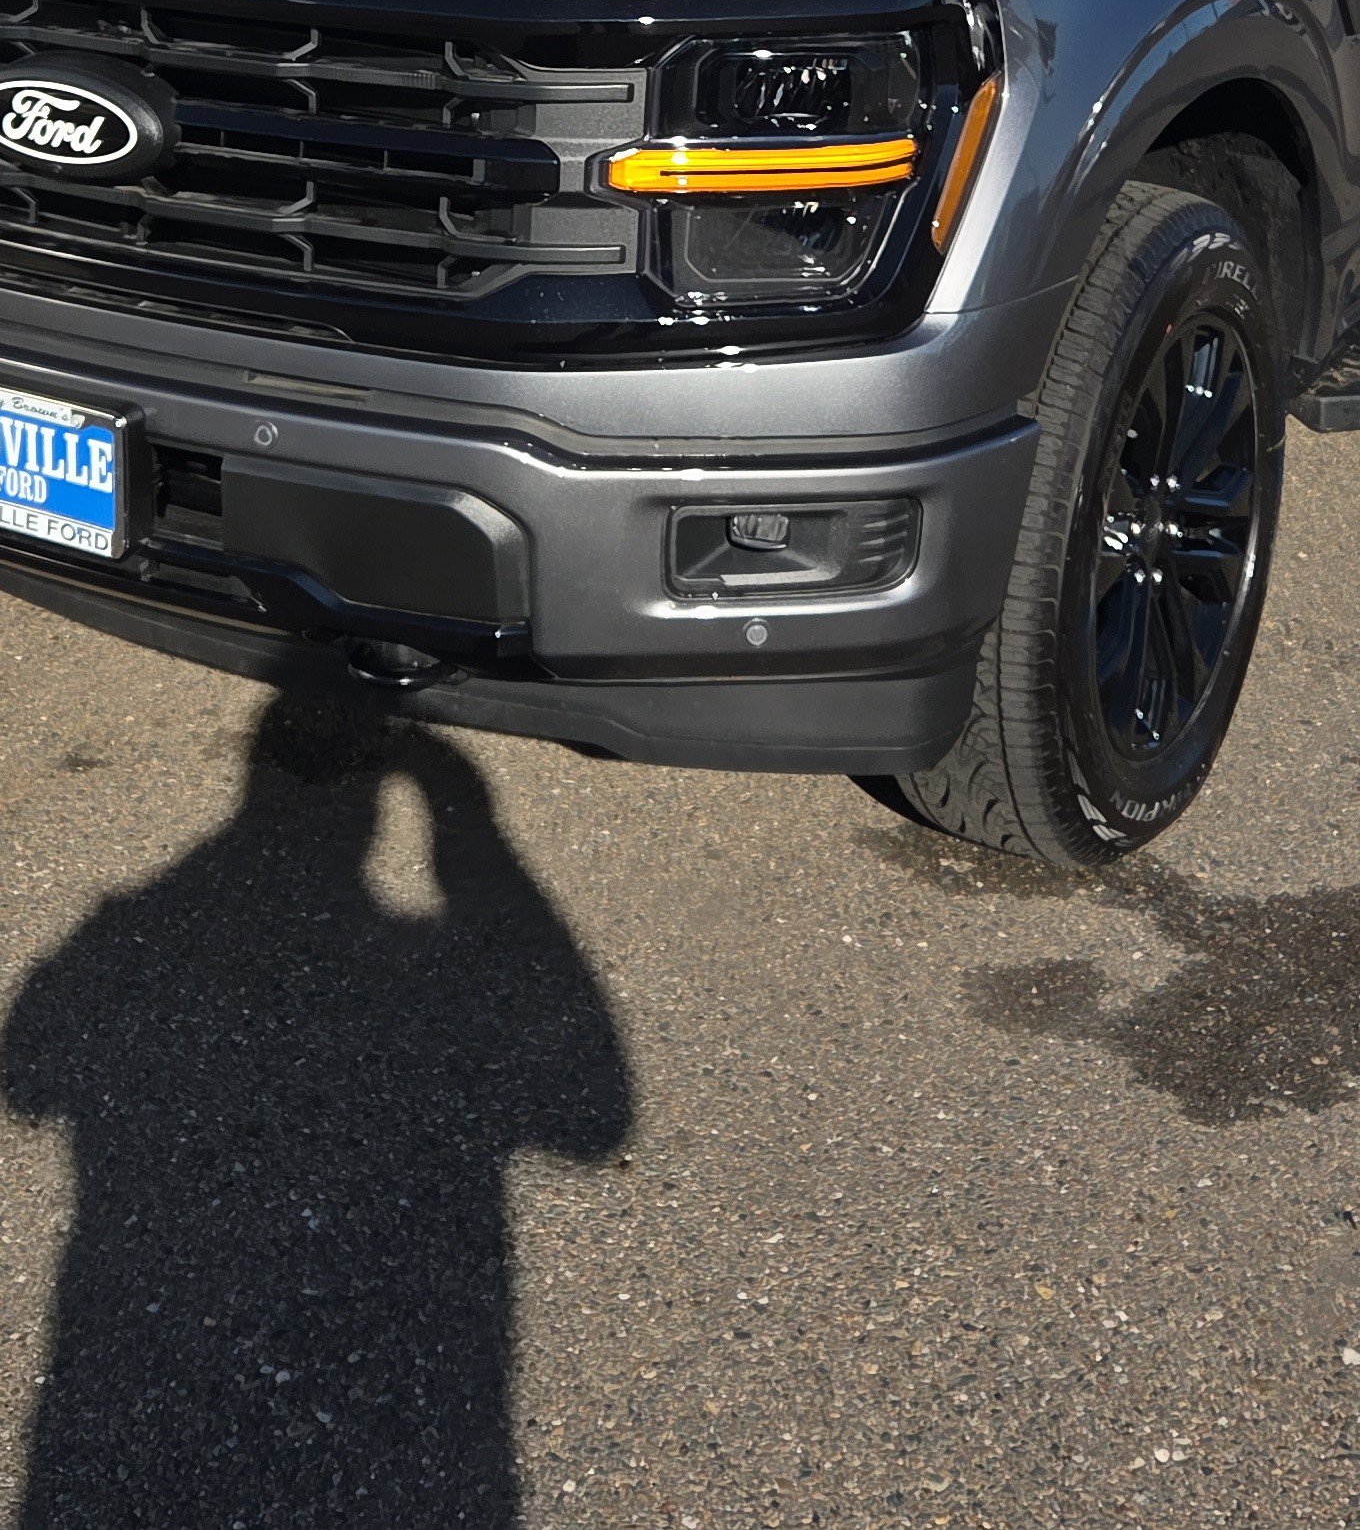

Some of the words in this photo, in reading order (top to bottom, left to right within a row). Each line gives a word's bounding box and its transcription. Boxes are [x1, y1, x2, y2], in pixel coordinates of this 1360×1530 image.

[1, 88, 106, 155] Ford
[12, 396, 69, 422] Brown's
[47, 518, 110, 552] FORD
